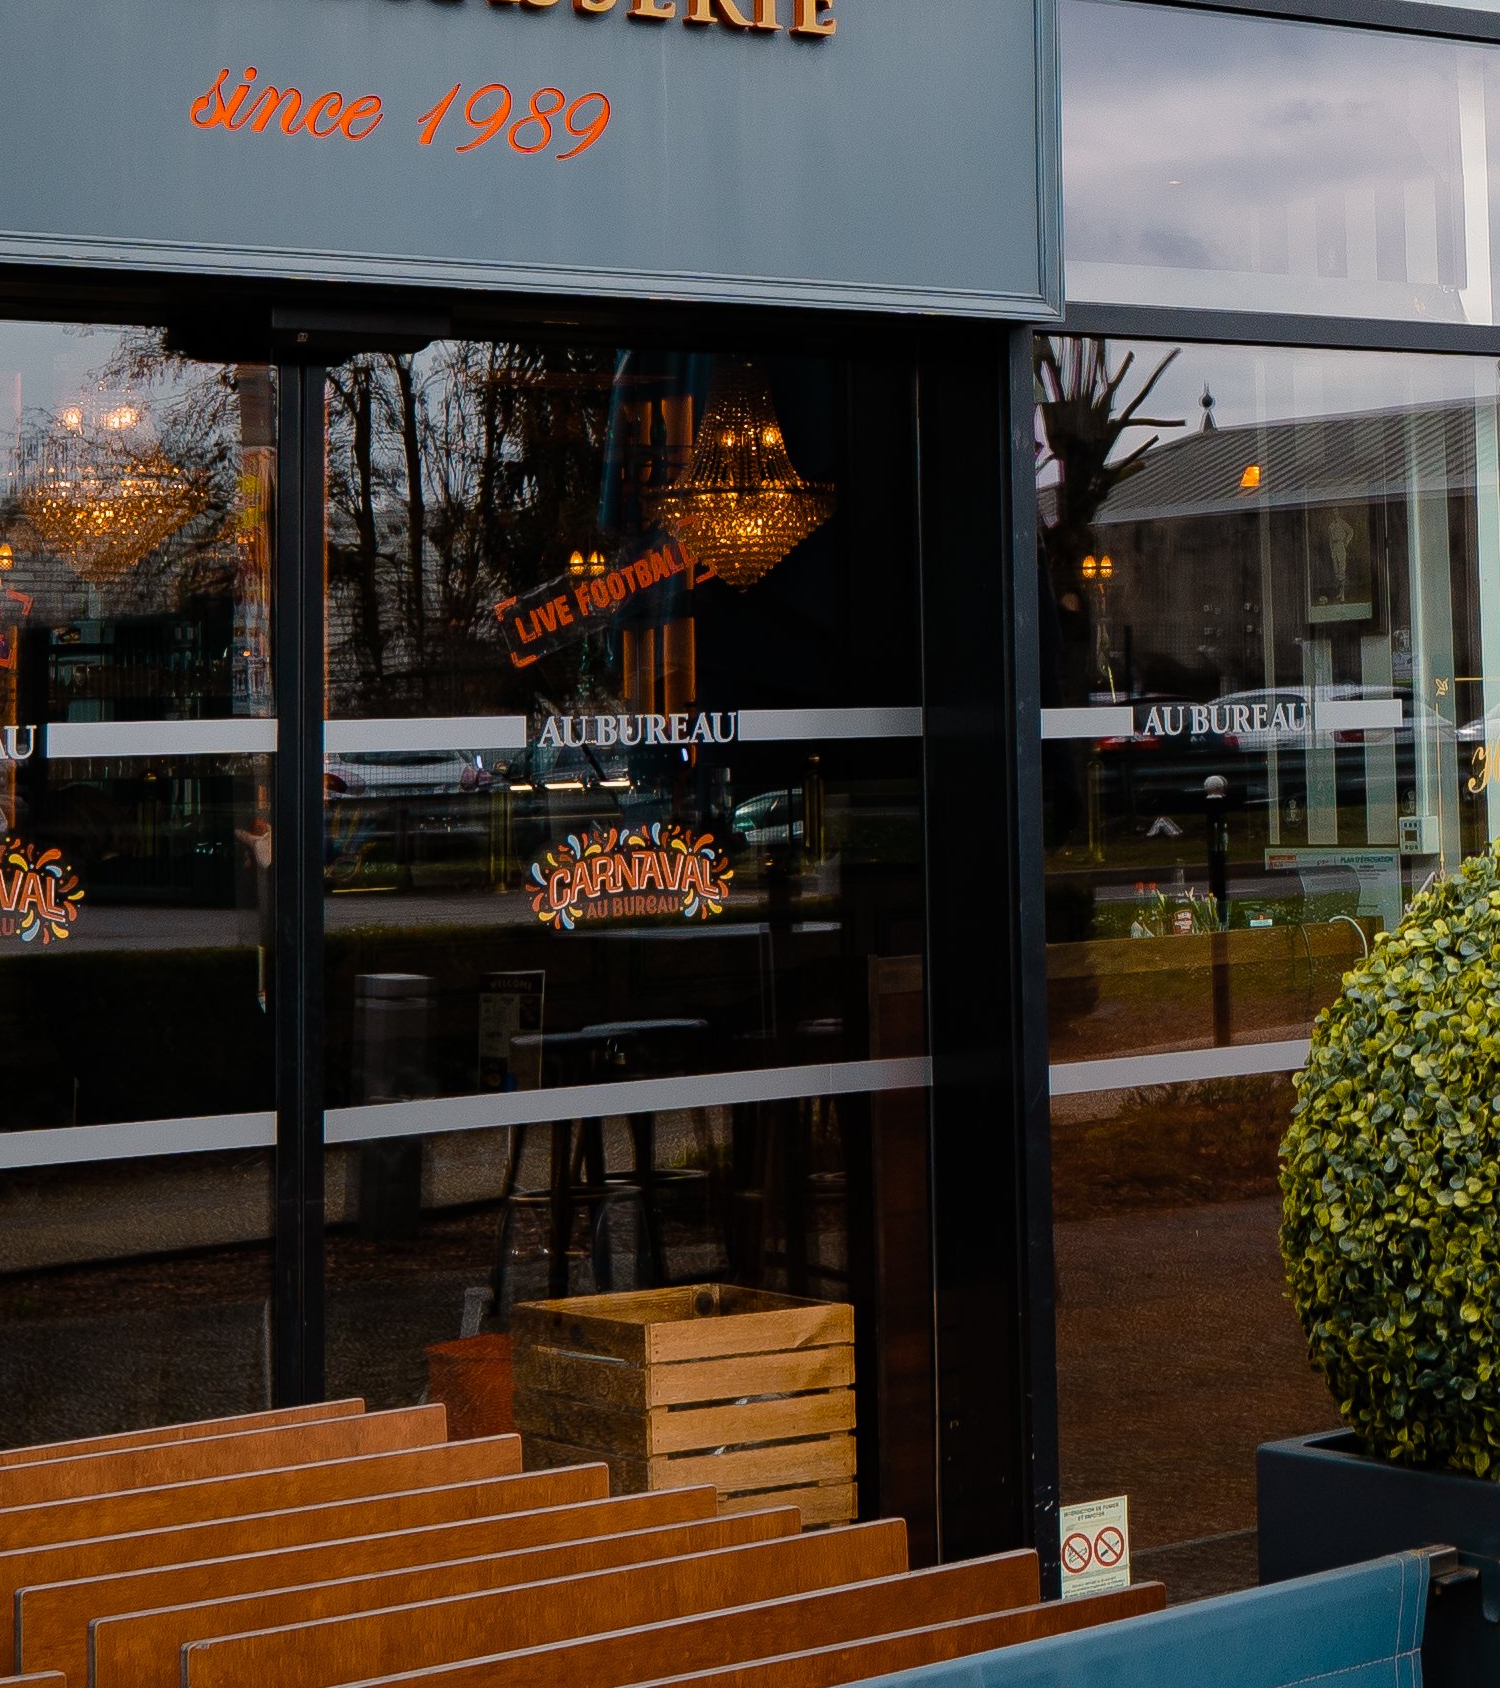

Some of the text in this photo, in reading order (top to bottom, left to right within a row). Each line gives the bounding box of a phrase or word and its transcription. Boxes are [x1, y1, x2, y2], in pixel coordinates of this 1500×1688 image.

[188, 66, 611, 160] since 1989
[515, 542, 698, 644] LIVE FOOTBALL
[537, 712, 737, 748] AU BUREAU
[1143, 702, 1308, 736] AU BUREAU
[550, 851, 720, 910] CARNAVAL
[587, 900, 608, 919] AU
